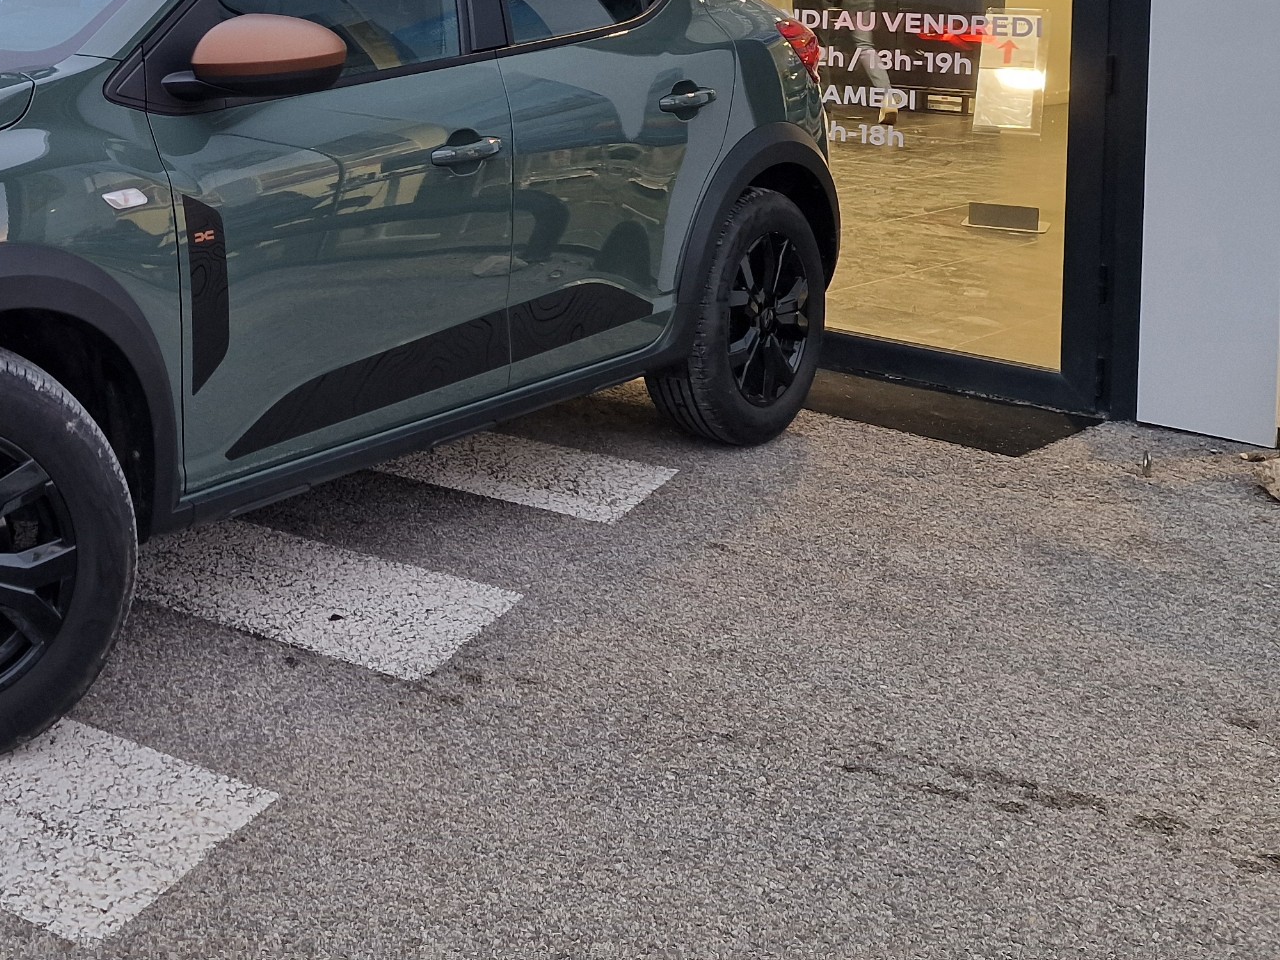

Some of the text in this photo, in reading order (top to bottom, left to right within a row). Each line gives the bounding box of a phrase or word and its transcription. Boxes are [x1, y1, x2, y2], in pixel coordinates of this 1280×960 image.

[833, 10, 876, 32] AU
[881, 12, 1043, 38] VENDREDI
[868, 49, 972, 75] 13h-19h
[821, 84, 916, 111] AMEDI
[829, 120, 904, 148] h-18h
